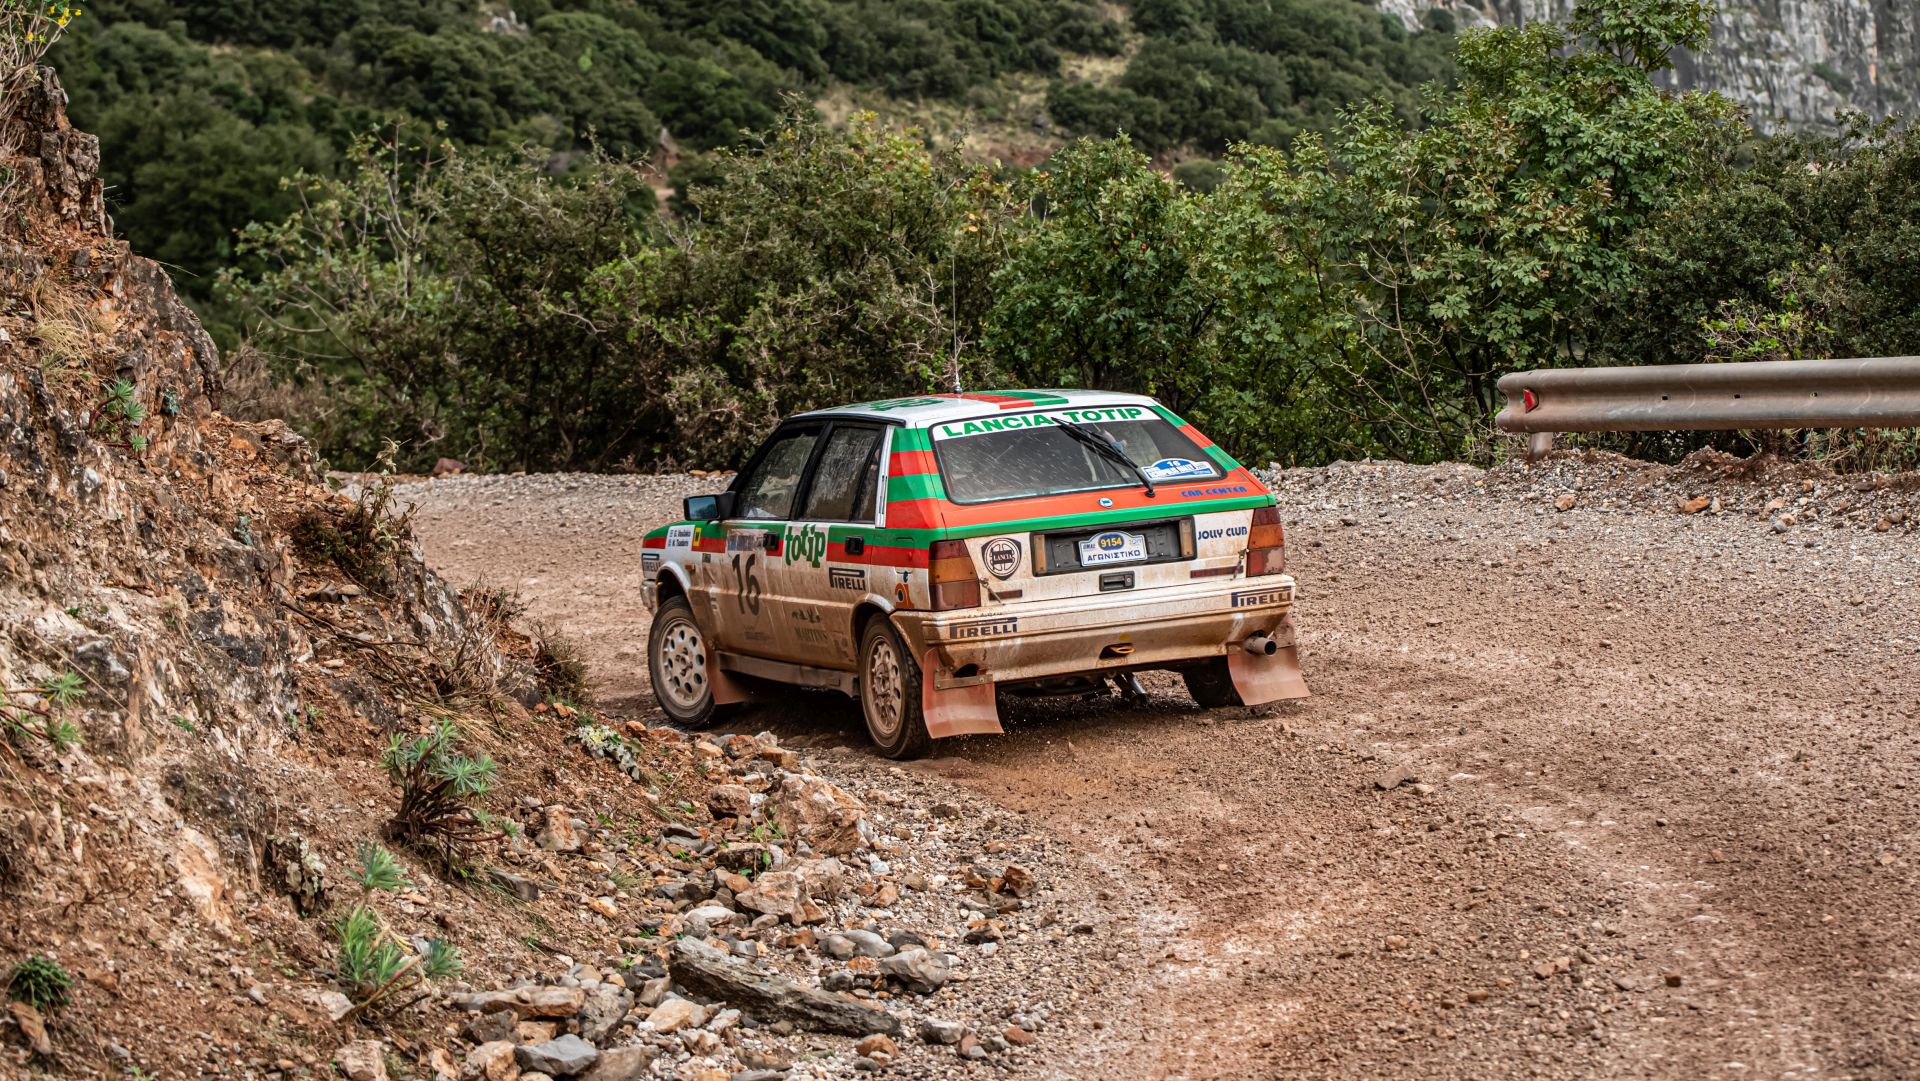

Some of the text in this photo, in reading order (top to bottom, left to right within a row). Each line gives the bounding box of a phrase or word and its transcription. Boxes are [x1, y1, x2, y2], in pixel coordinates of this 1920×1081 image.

[942, 408, 1142, 437] LANCIA TOTIP
[1181, 486, 1247, 497] CAR CENTER
[1100, 537, 1122, 548] 9154
[1198, 526, 1248, 540] JOLLY CLUB
[785, 524, 826, 568] totip
[1087, 550, 1141, 561] ΑΓΩΝΙΣΤΙΚΟ
[732, 554, 761, 616] 16
[829, 567, 866, 591] PIRELLI
[1231, 585, 1292, 607] PIRELLI
[950, 617, 1017, 639] PIRELLI
